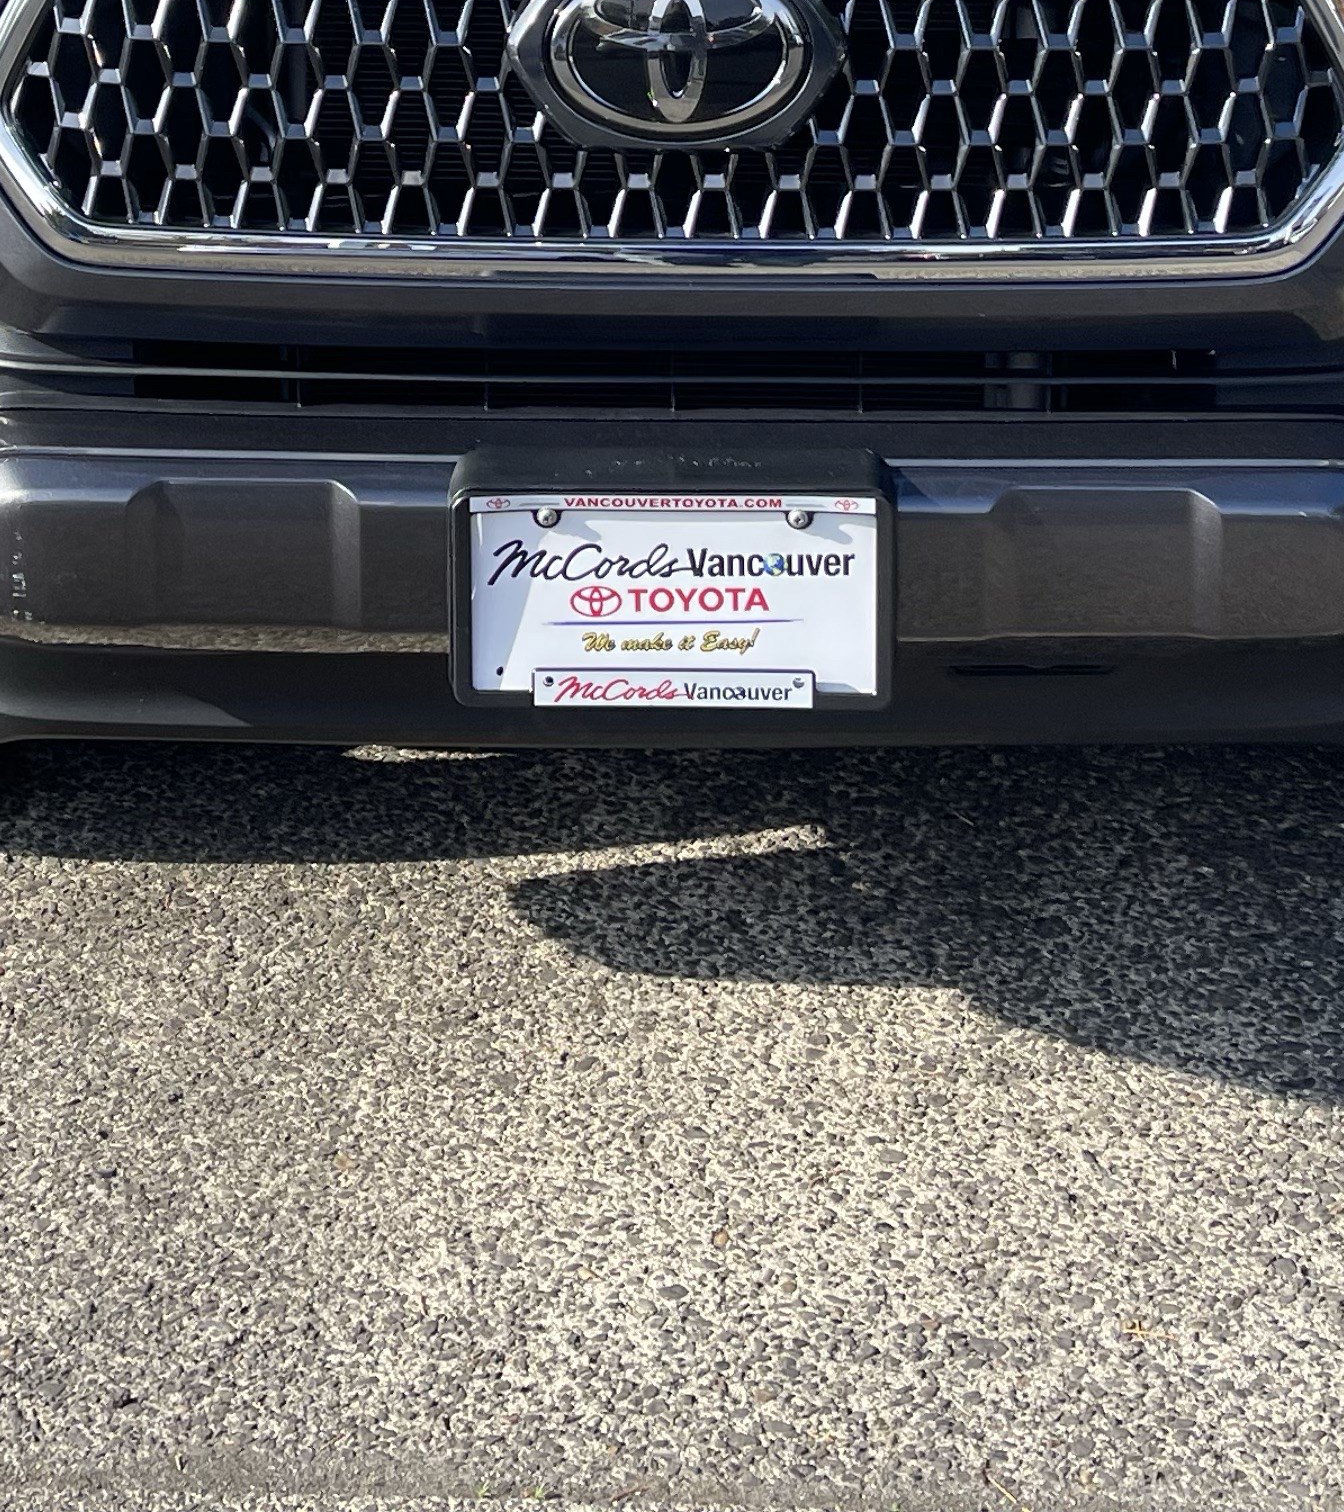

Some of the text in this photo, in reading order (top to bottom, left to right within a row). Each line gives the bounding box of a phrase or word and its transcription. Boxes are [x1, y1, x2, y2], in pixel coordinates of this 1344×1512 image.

[563, 496, 783, 509] VANCOUVERTOYOTA.COM
[627, 587, 770, 612] TOYOTA
[581, 627, 761, 656] We make it Easy!
